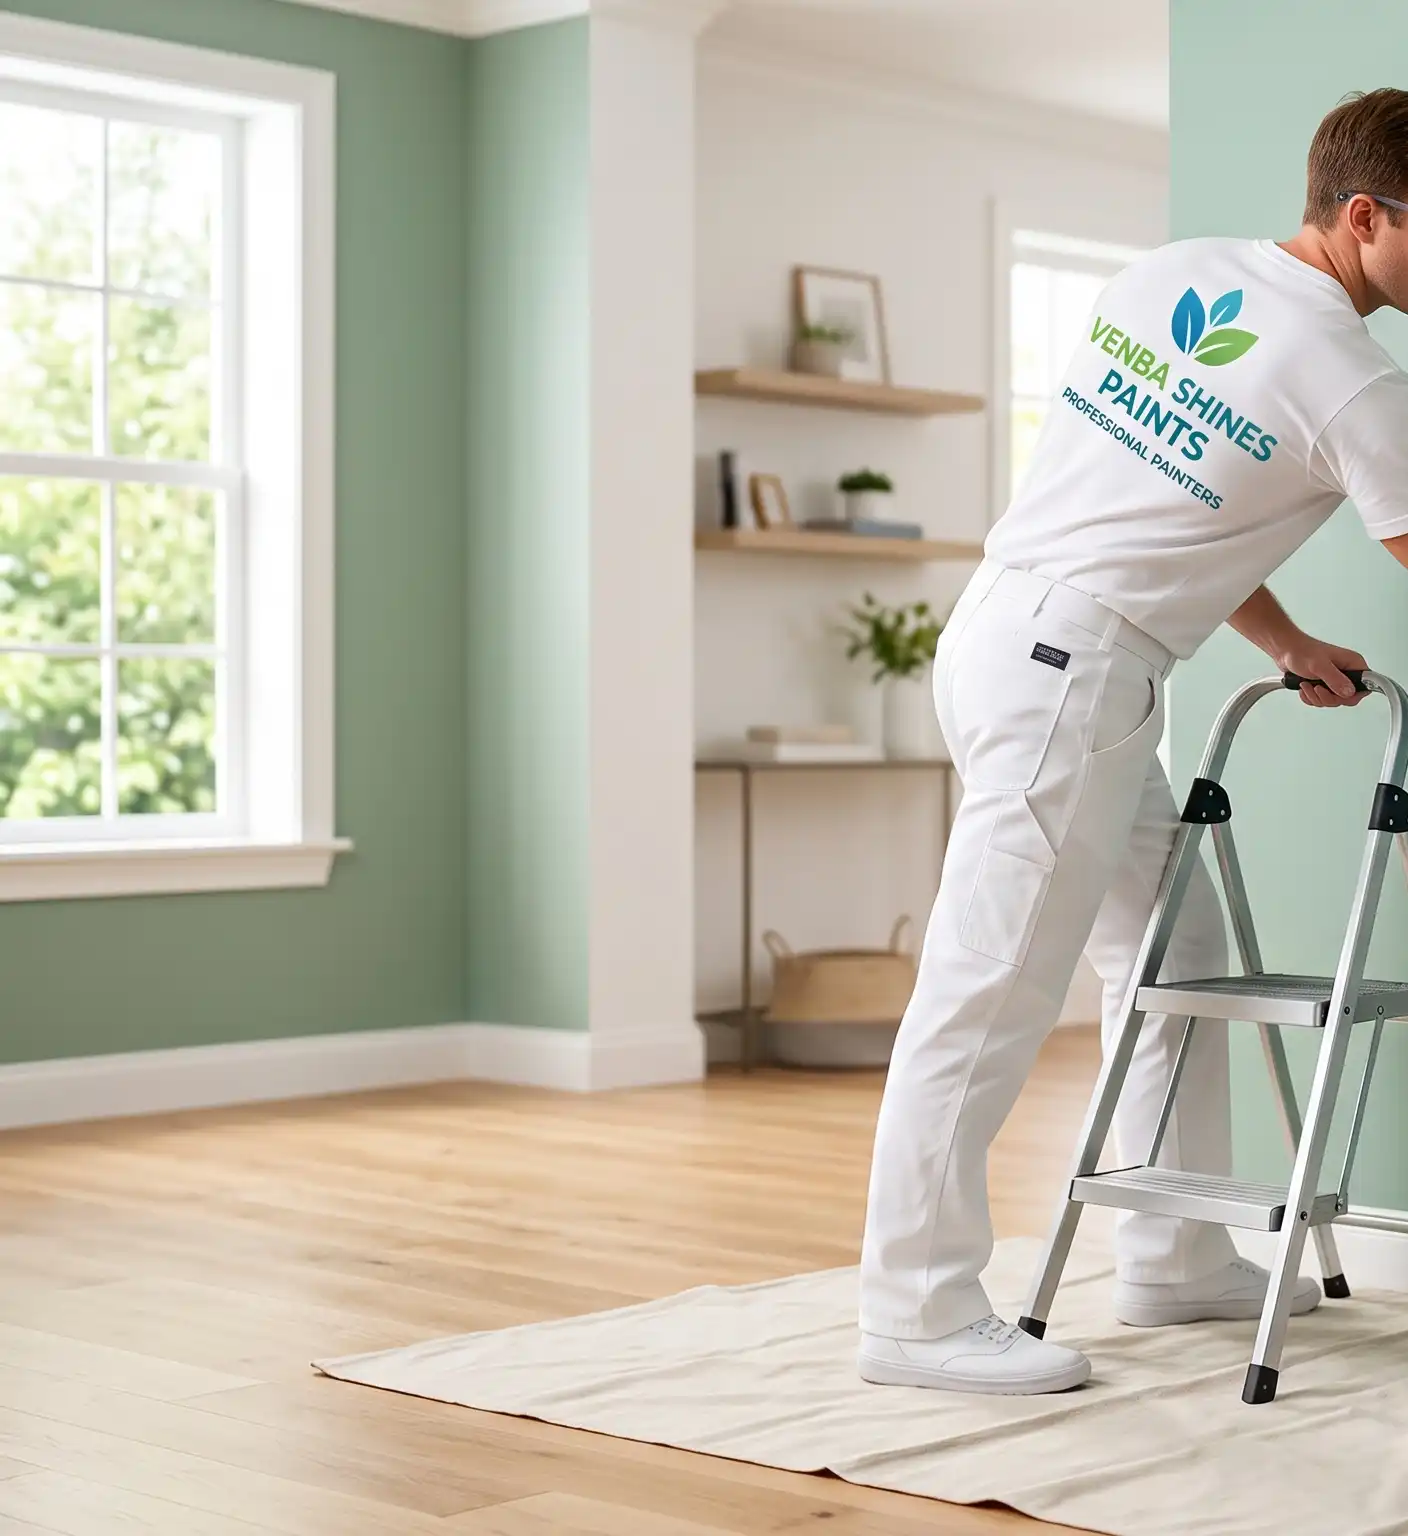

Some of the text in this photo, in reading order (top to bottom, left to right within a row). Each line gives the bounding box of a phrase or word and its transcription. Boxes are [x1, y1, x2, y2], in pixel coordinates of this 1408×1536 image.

[1062, 387, 1224, 510] PROFESSIONAL PAINTERS
[1089, 316, 1278, 462] VENBA SHINES
[1098, 369, 1210, 461] PAINTS
